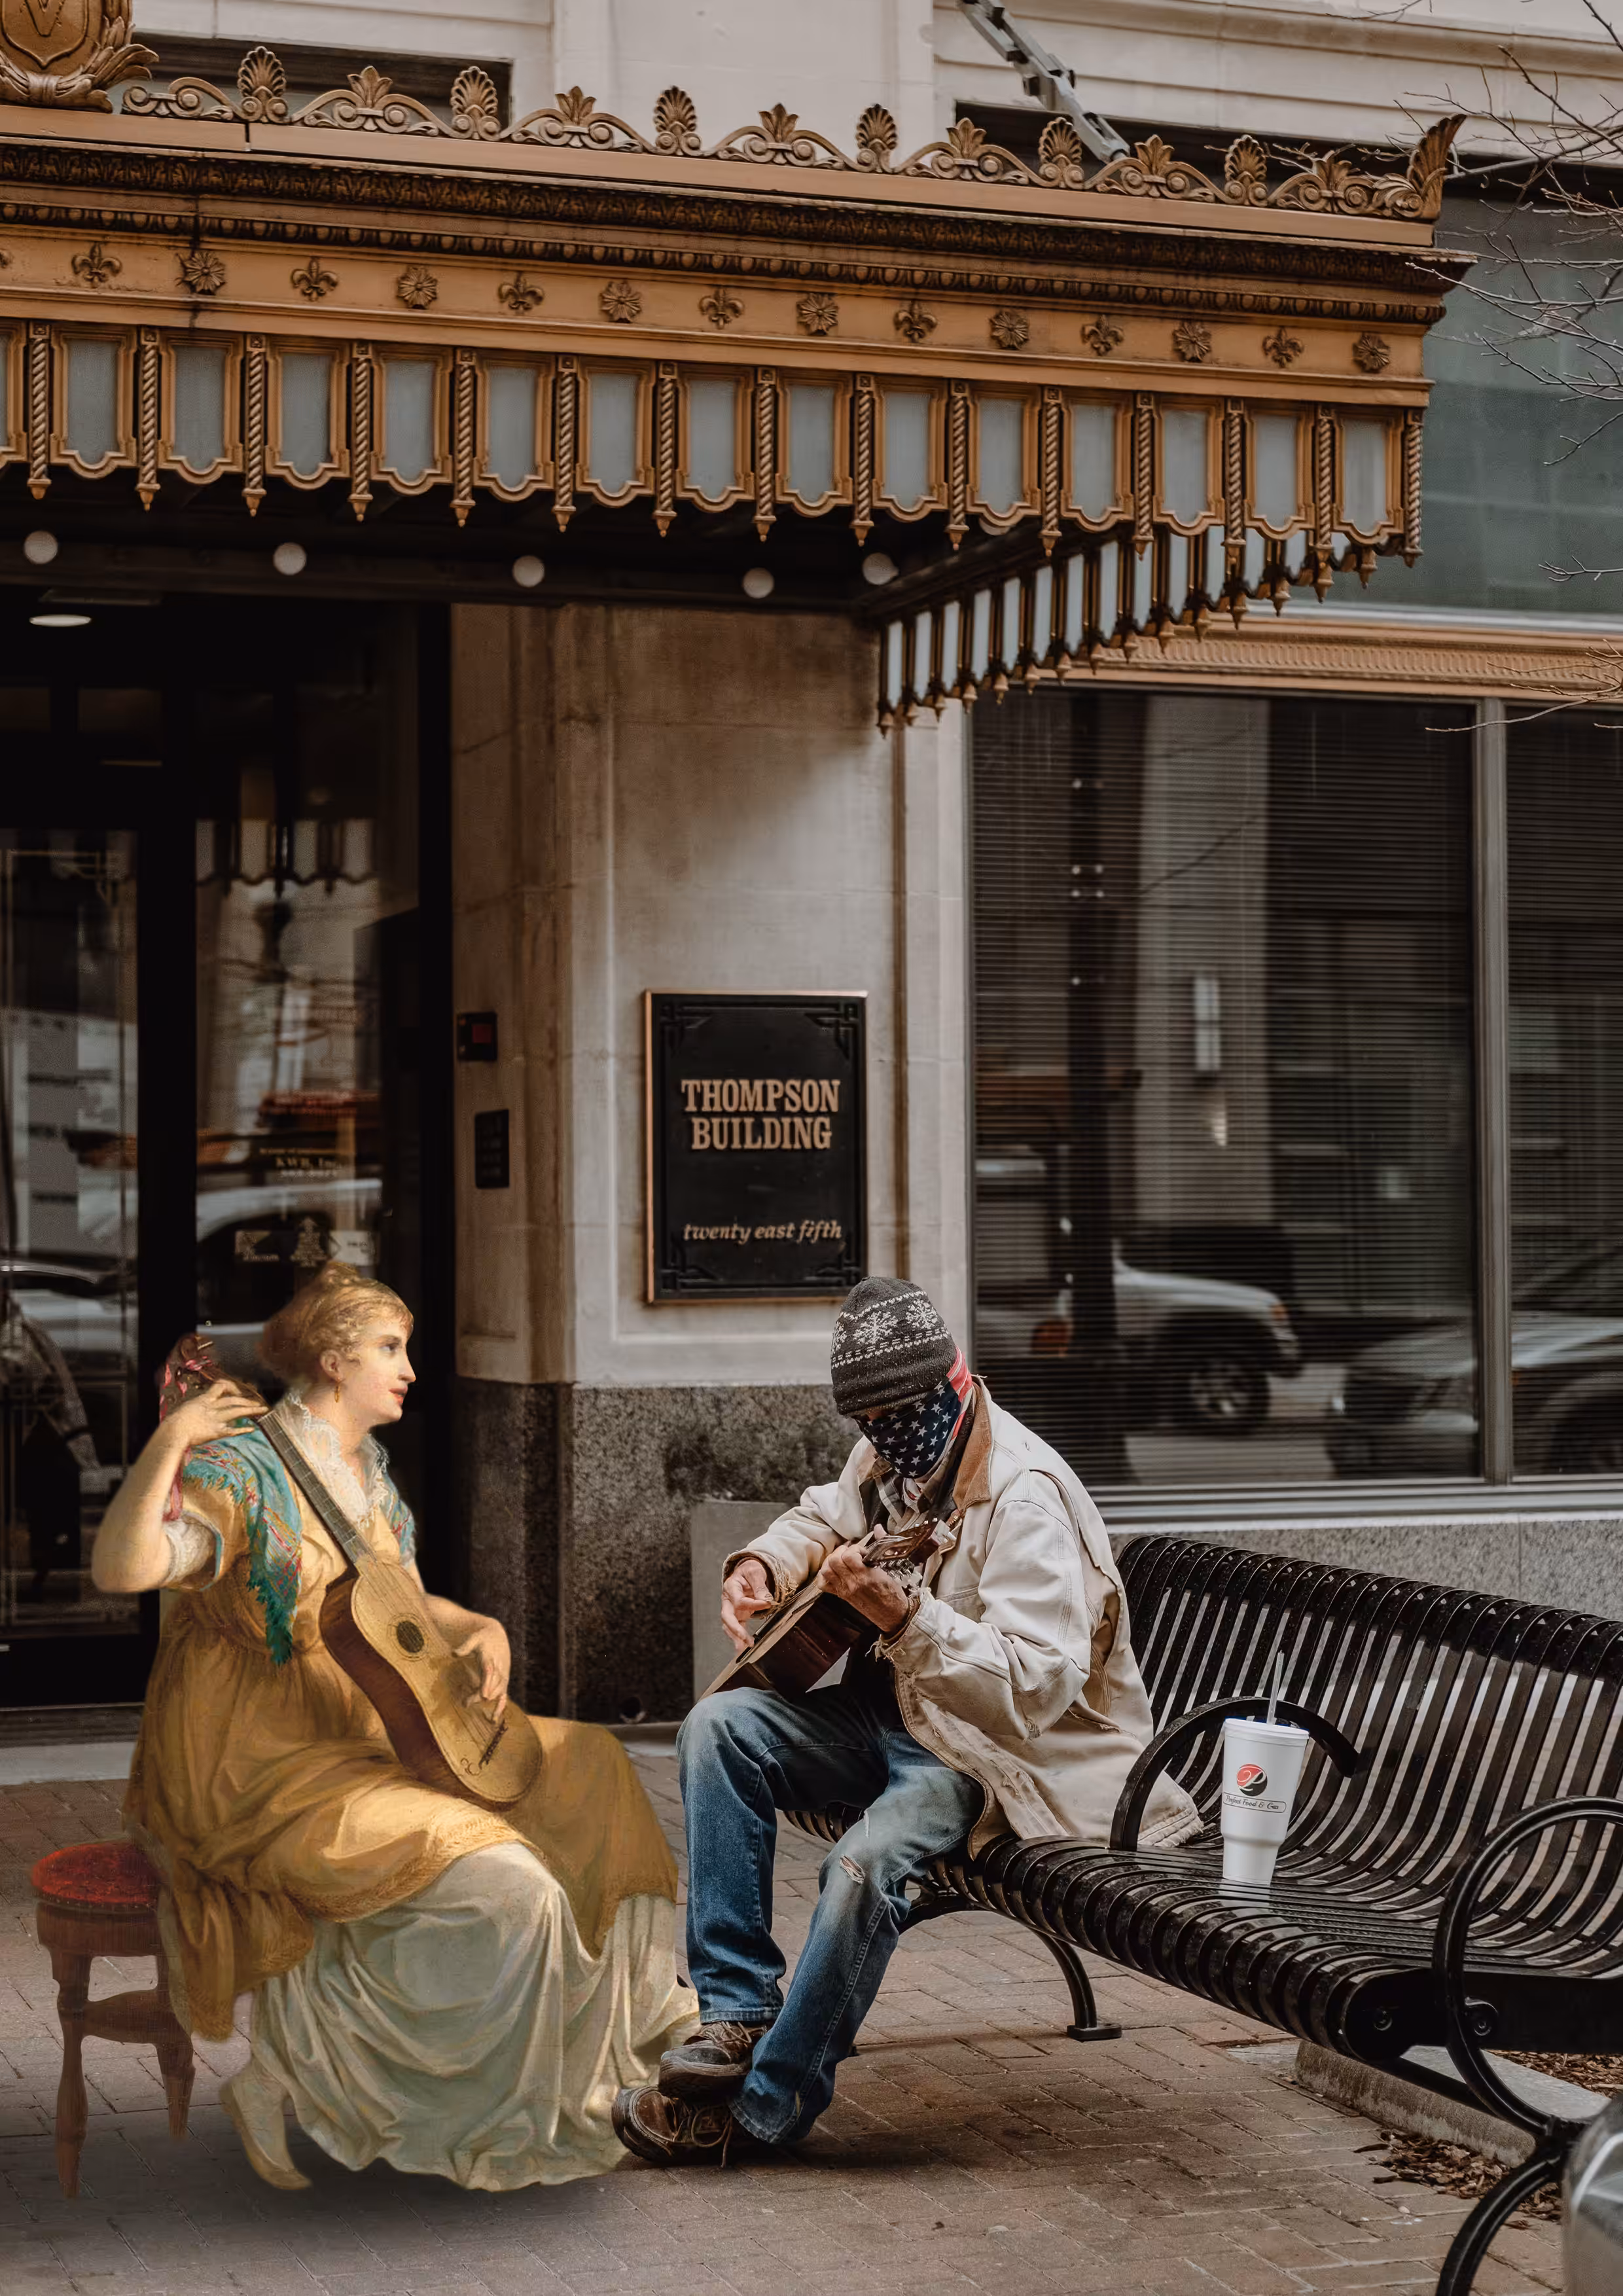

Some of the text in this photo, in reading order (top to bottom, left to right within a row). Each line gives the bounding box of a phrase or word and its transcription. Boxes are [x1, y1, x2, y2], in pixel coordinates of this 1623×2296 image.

[681, 1079, 840, 1113] THOMPSON
[691, 1117, 832, 1151] BUILDING
[684, 1219, 842, 1244] twenty east fifth
[1243, 1799, 1257, 1807] Food
